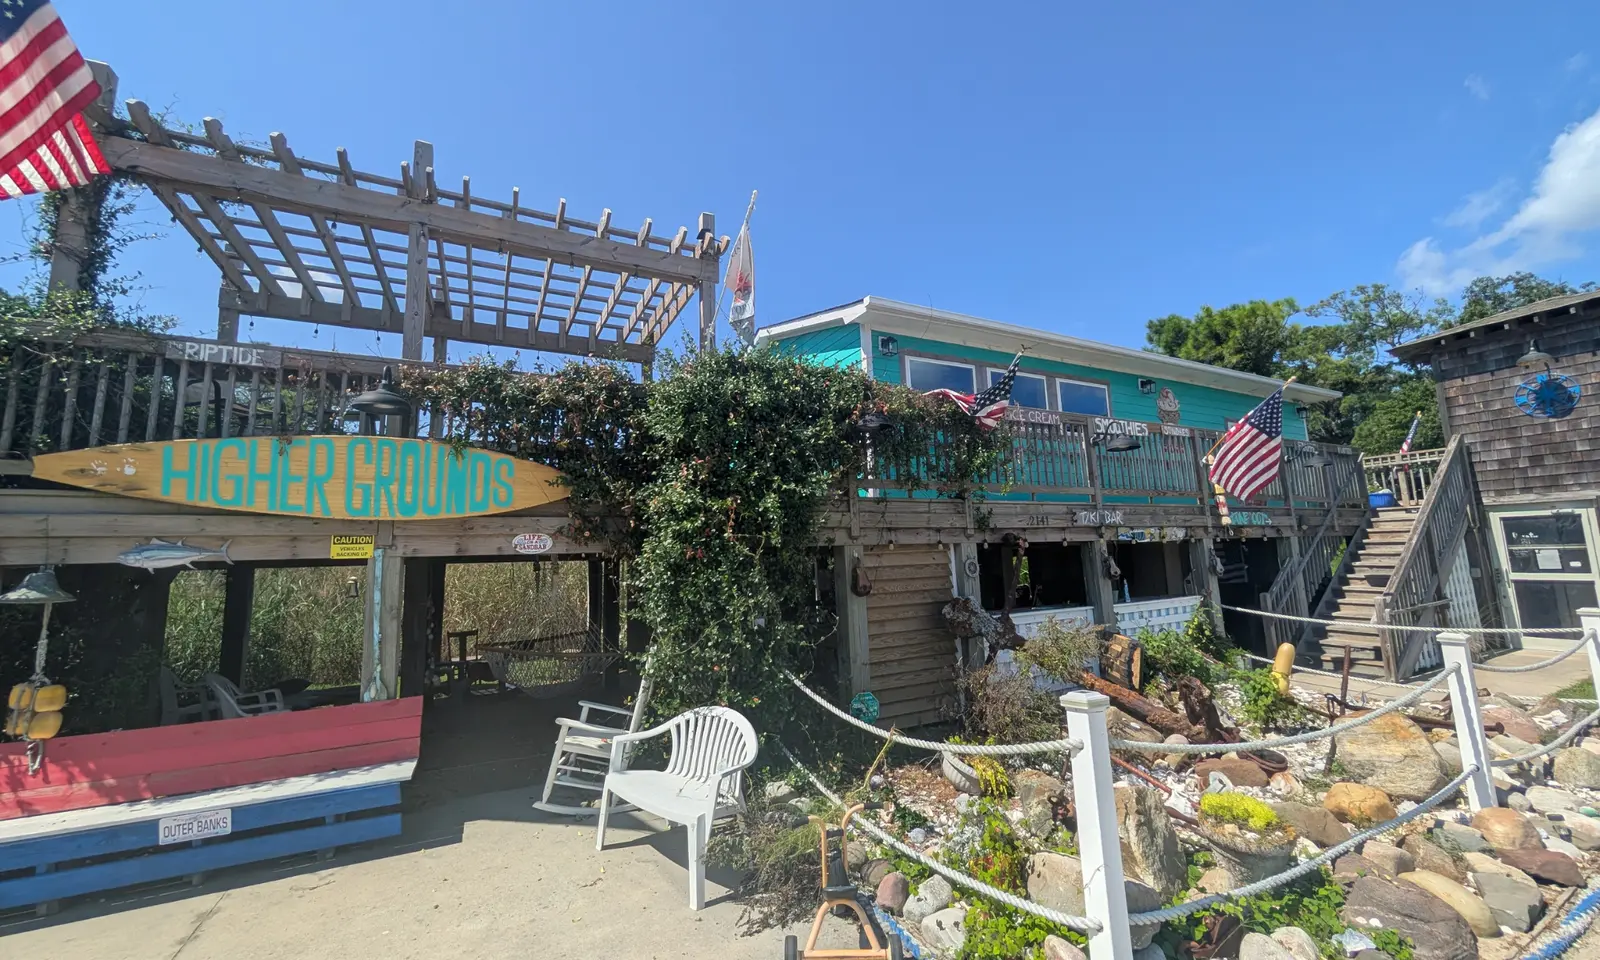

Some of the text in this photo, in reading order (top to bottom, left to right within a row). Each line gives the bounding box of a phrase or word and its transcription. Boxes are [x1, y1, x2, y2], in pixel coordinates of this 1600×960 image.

[184, 342, 265, 366] RIPTIDE
[1028, 411, 1061, 425] CREAM
[1094, 417, 1149, 436] SMOOTHIES
[161, 438, 515, 518] HIGHER GROUNDS
[1080, 510, 1124, 525] TIKI BAR
[333, 536, 373, 544] CAUTION
[163, 822, 193, 838] OUTER
[196, 817, 228, 832] BANKS
